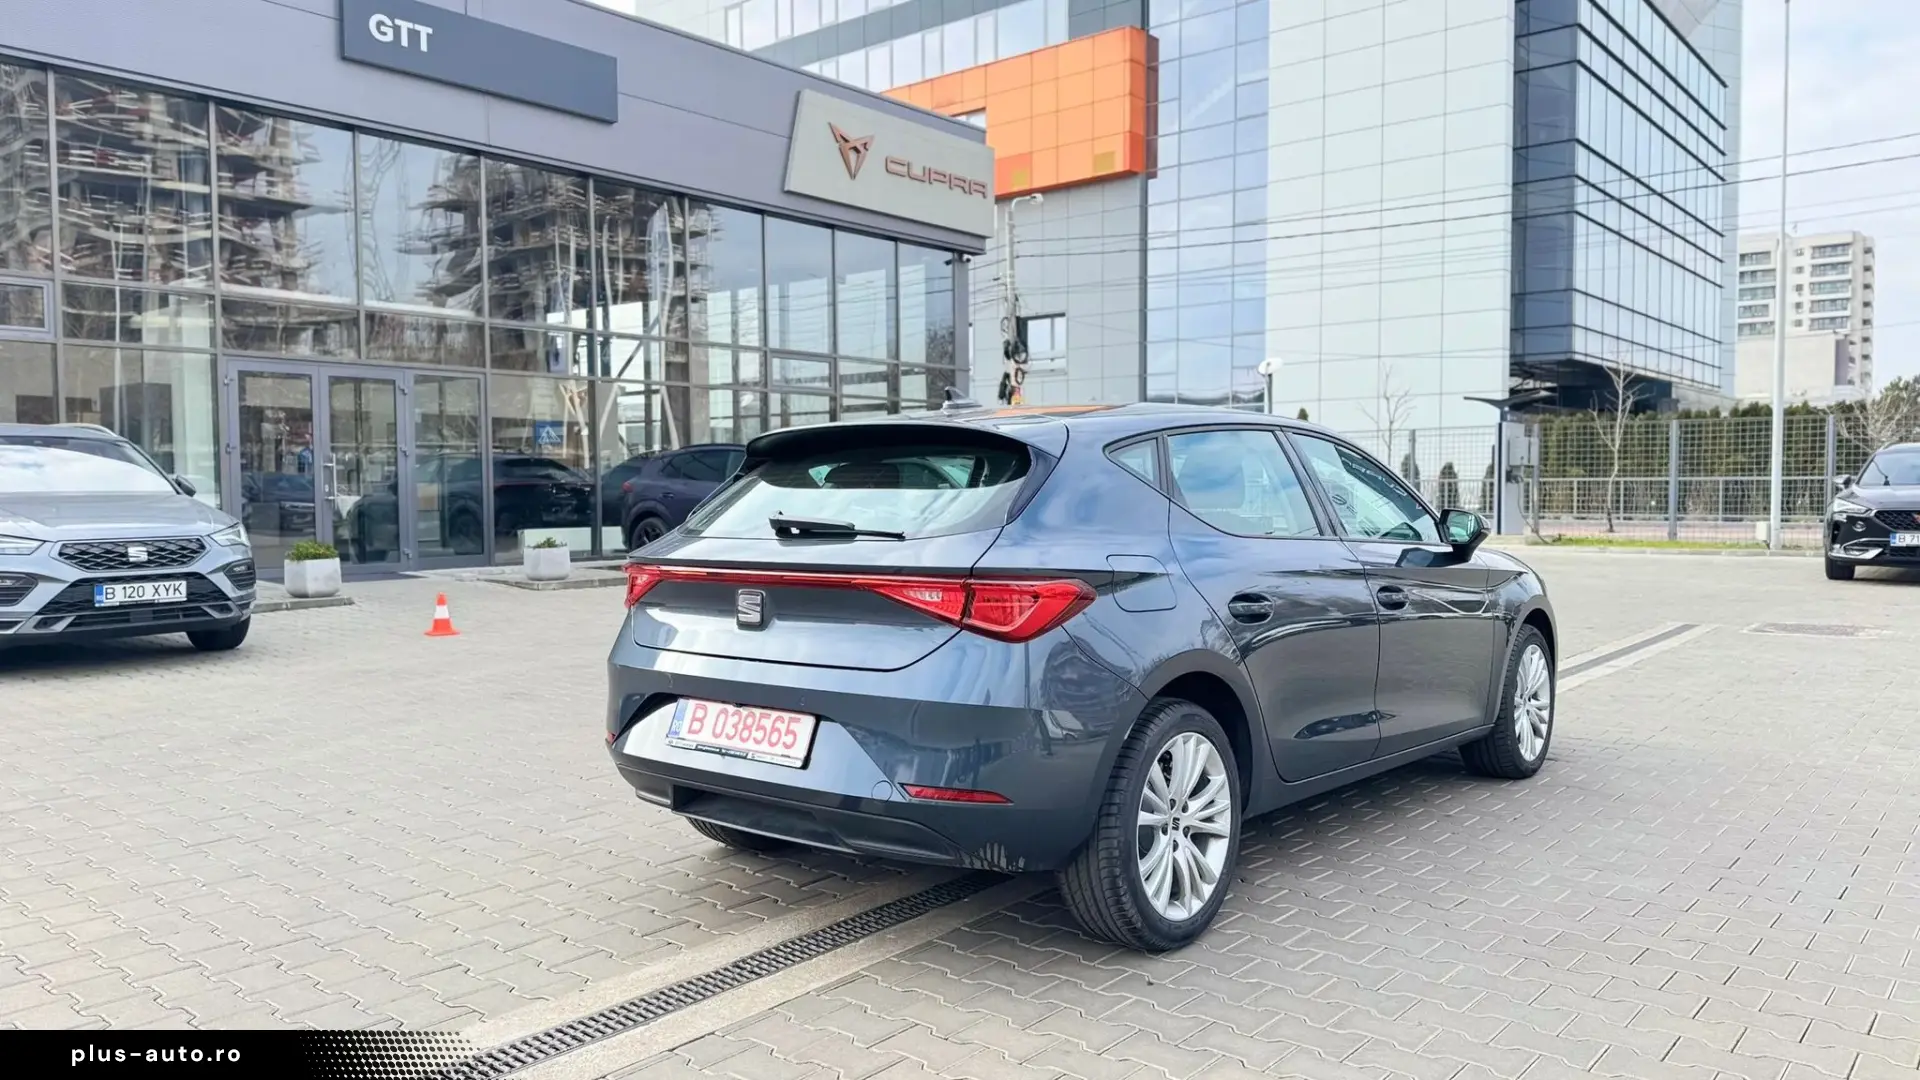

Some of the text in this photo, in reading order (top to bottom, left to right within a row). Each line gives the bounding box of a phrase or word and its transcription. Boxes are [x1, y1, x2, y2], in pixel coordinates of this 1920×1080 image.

[369, 13, 433, 52] GTT
[885, 156, 987, 199] CUPRA
[1898, 534, 1906, 543] B
[105, 587, 116, 600] B
[122, 585, 146, 599] 120
[152, 583, 183, 598] XYK
[687, 703, 801, 750] B 038565
